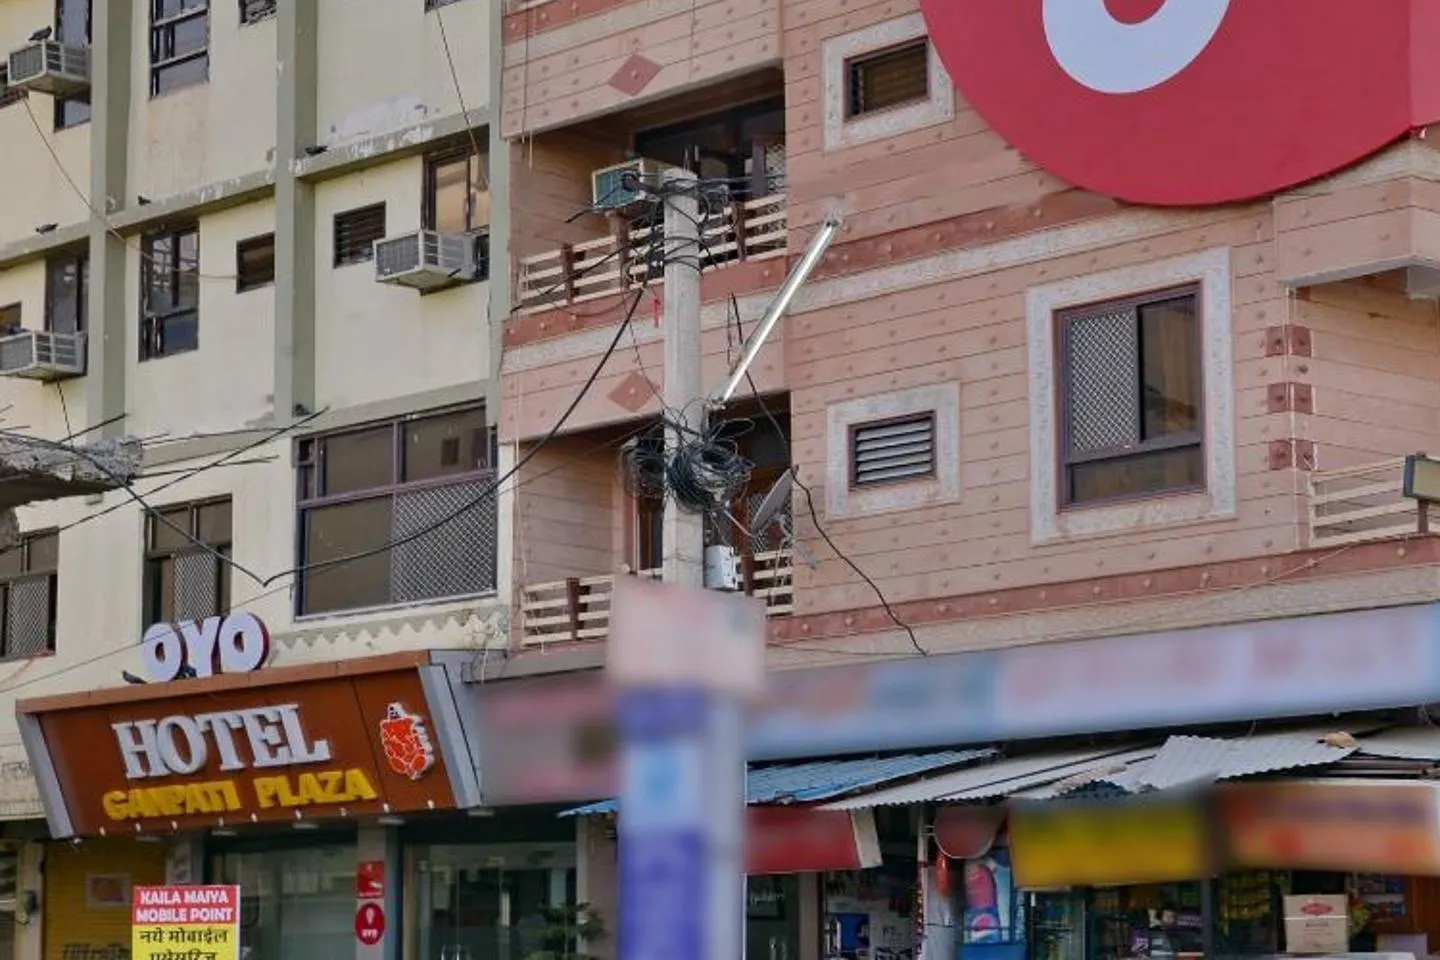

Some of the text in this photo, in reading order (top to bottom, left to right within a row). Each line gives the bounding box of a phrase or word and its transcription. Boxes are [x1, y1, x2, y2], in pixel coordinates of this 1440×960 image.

[142, 611, 269, 683] OYO
[112, 703, 332, 779] HOTEL
[102, 768, 377, 821] GANPATI PLAZA
[136, 907, 234, 923] MOBILE POINT
[140, 889, 229, 904] KAILA MAIYA
